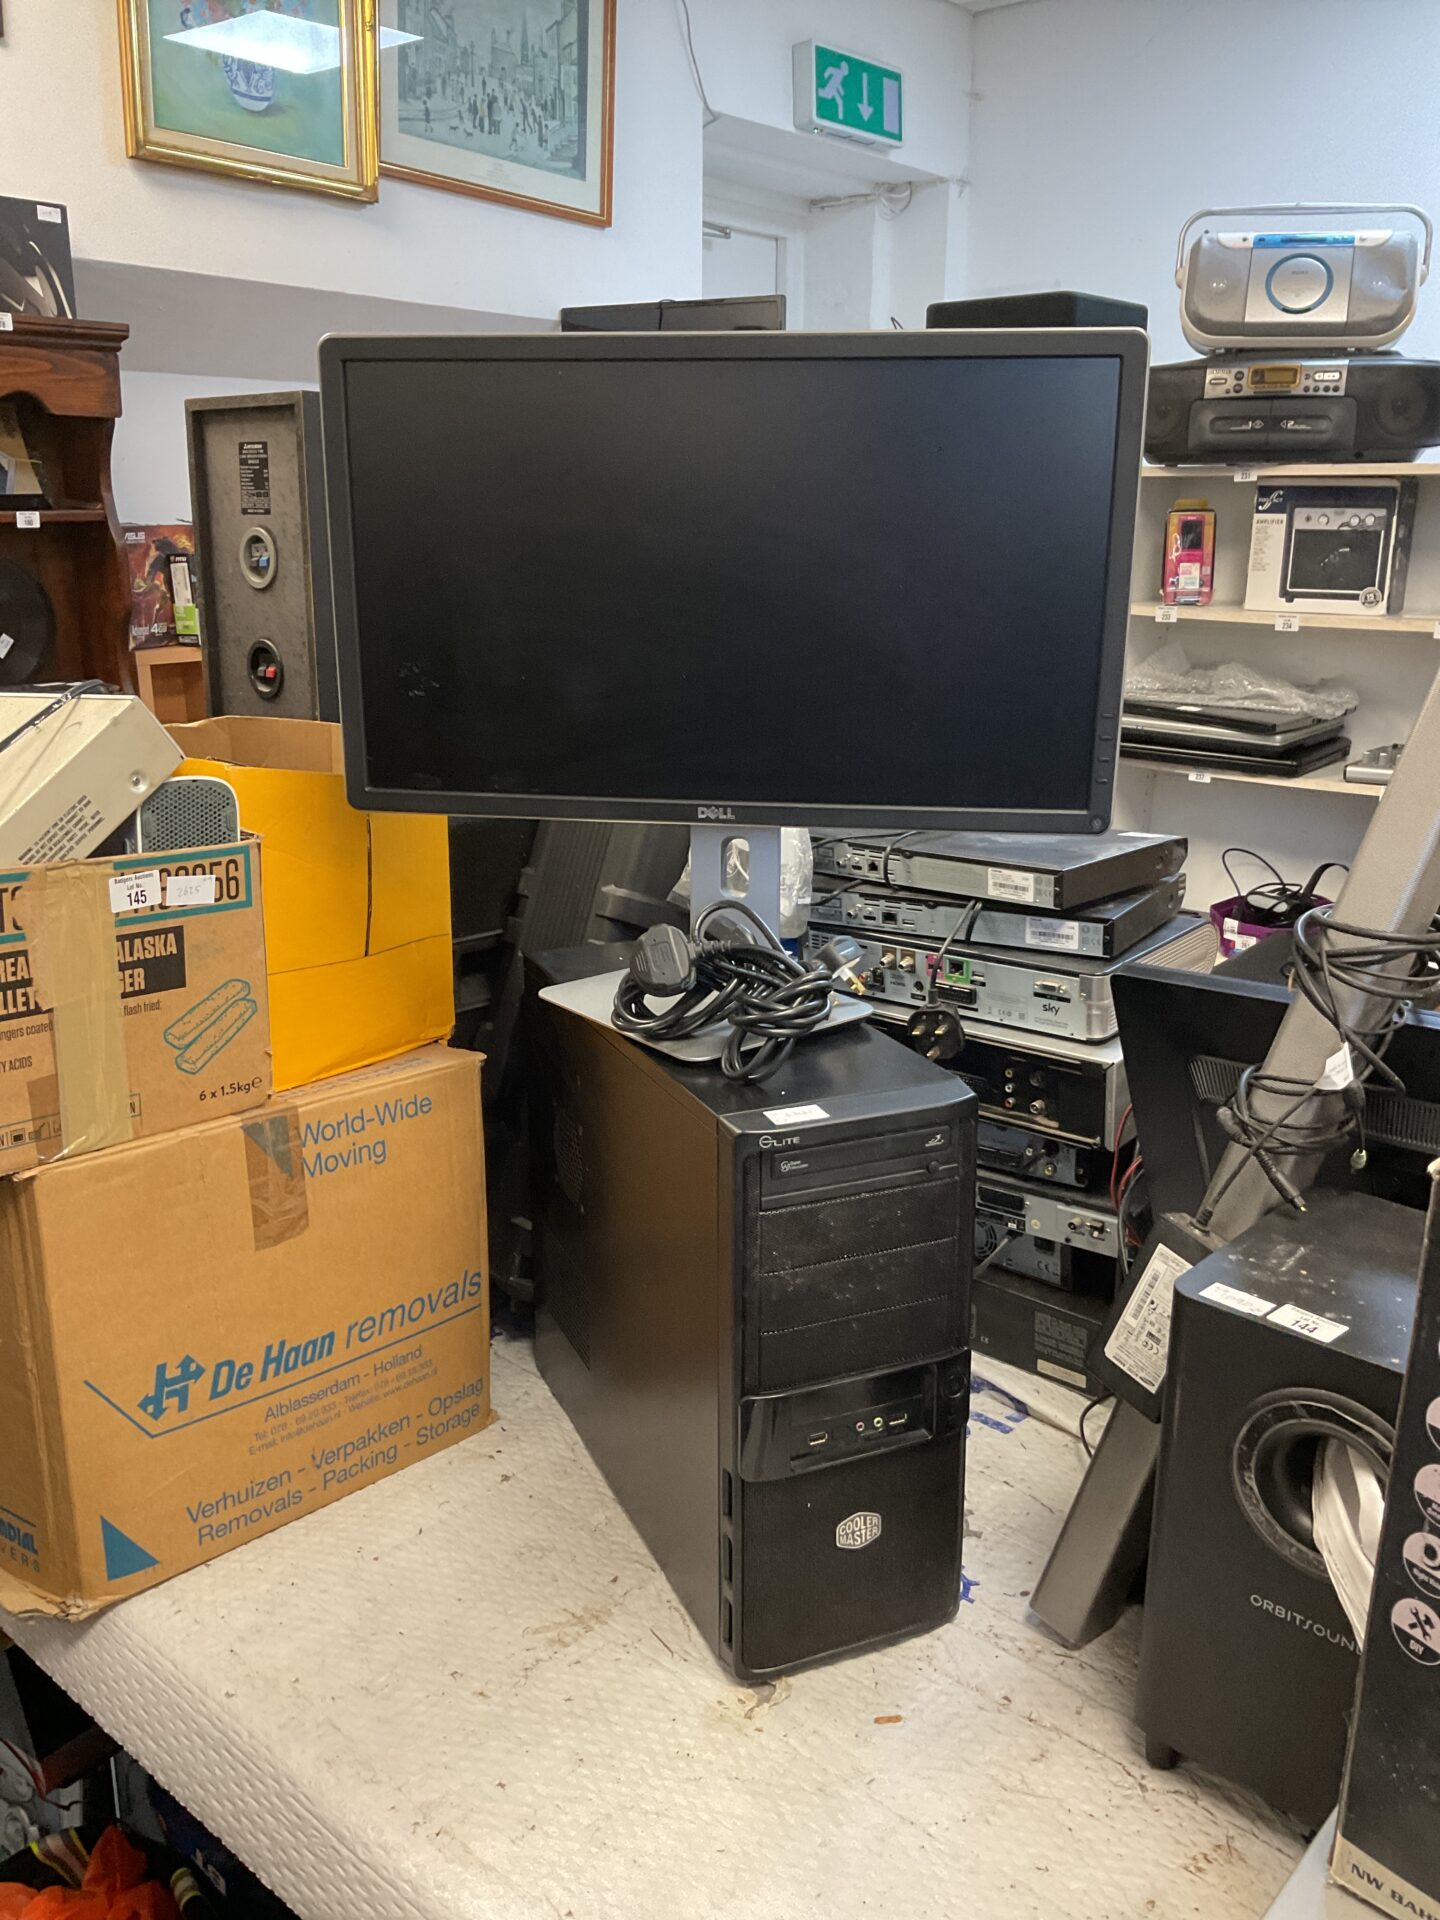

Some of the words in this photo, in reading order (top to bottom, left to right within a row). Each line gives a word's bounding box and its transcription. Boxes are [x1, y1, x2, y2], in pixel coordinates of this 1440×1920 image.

[698, 806, 735, 820] DELL
[127, 890, 147, 906] 145
[123, 1004, 142, 1017] flash
[1042, 1002, 1060, 1016] sky
[8, 1056, 33, 1072] ACIDS
[199, 1090, 206, 1101] 6
[210, 1090, 217, 1099] x
[301, 1094, 433, 1148] World-Wide
[302, 1139, 387, 1178] Moving
[208, 1359, 254, 1401] De
[259, 1330, 336, 1383] Haan
[345, 1268, 482, 1350] removals
[1291, 1320, 1318, 1333] 144
[264, 1373, 361, 1423] Alblasserdam
[373, 1344, 423, 1377] Holland
[186, 1469, 291, 1524] Verhuizen
[312, 1415, 410, 1470] Verpakken
[428, 1377, 484, 1420] Opslag
[198, 1487, 303, 1546] Removals
[323, 1444, 398, 1490] Packing
[416, 1403, 480, 1446] Storage
[839, 1515, 879, 1535] COOLER
[839, 1526, 879, 1545] MASTER
[1351, 1863, 1384, 1890] NW
